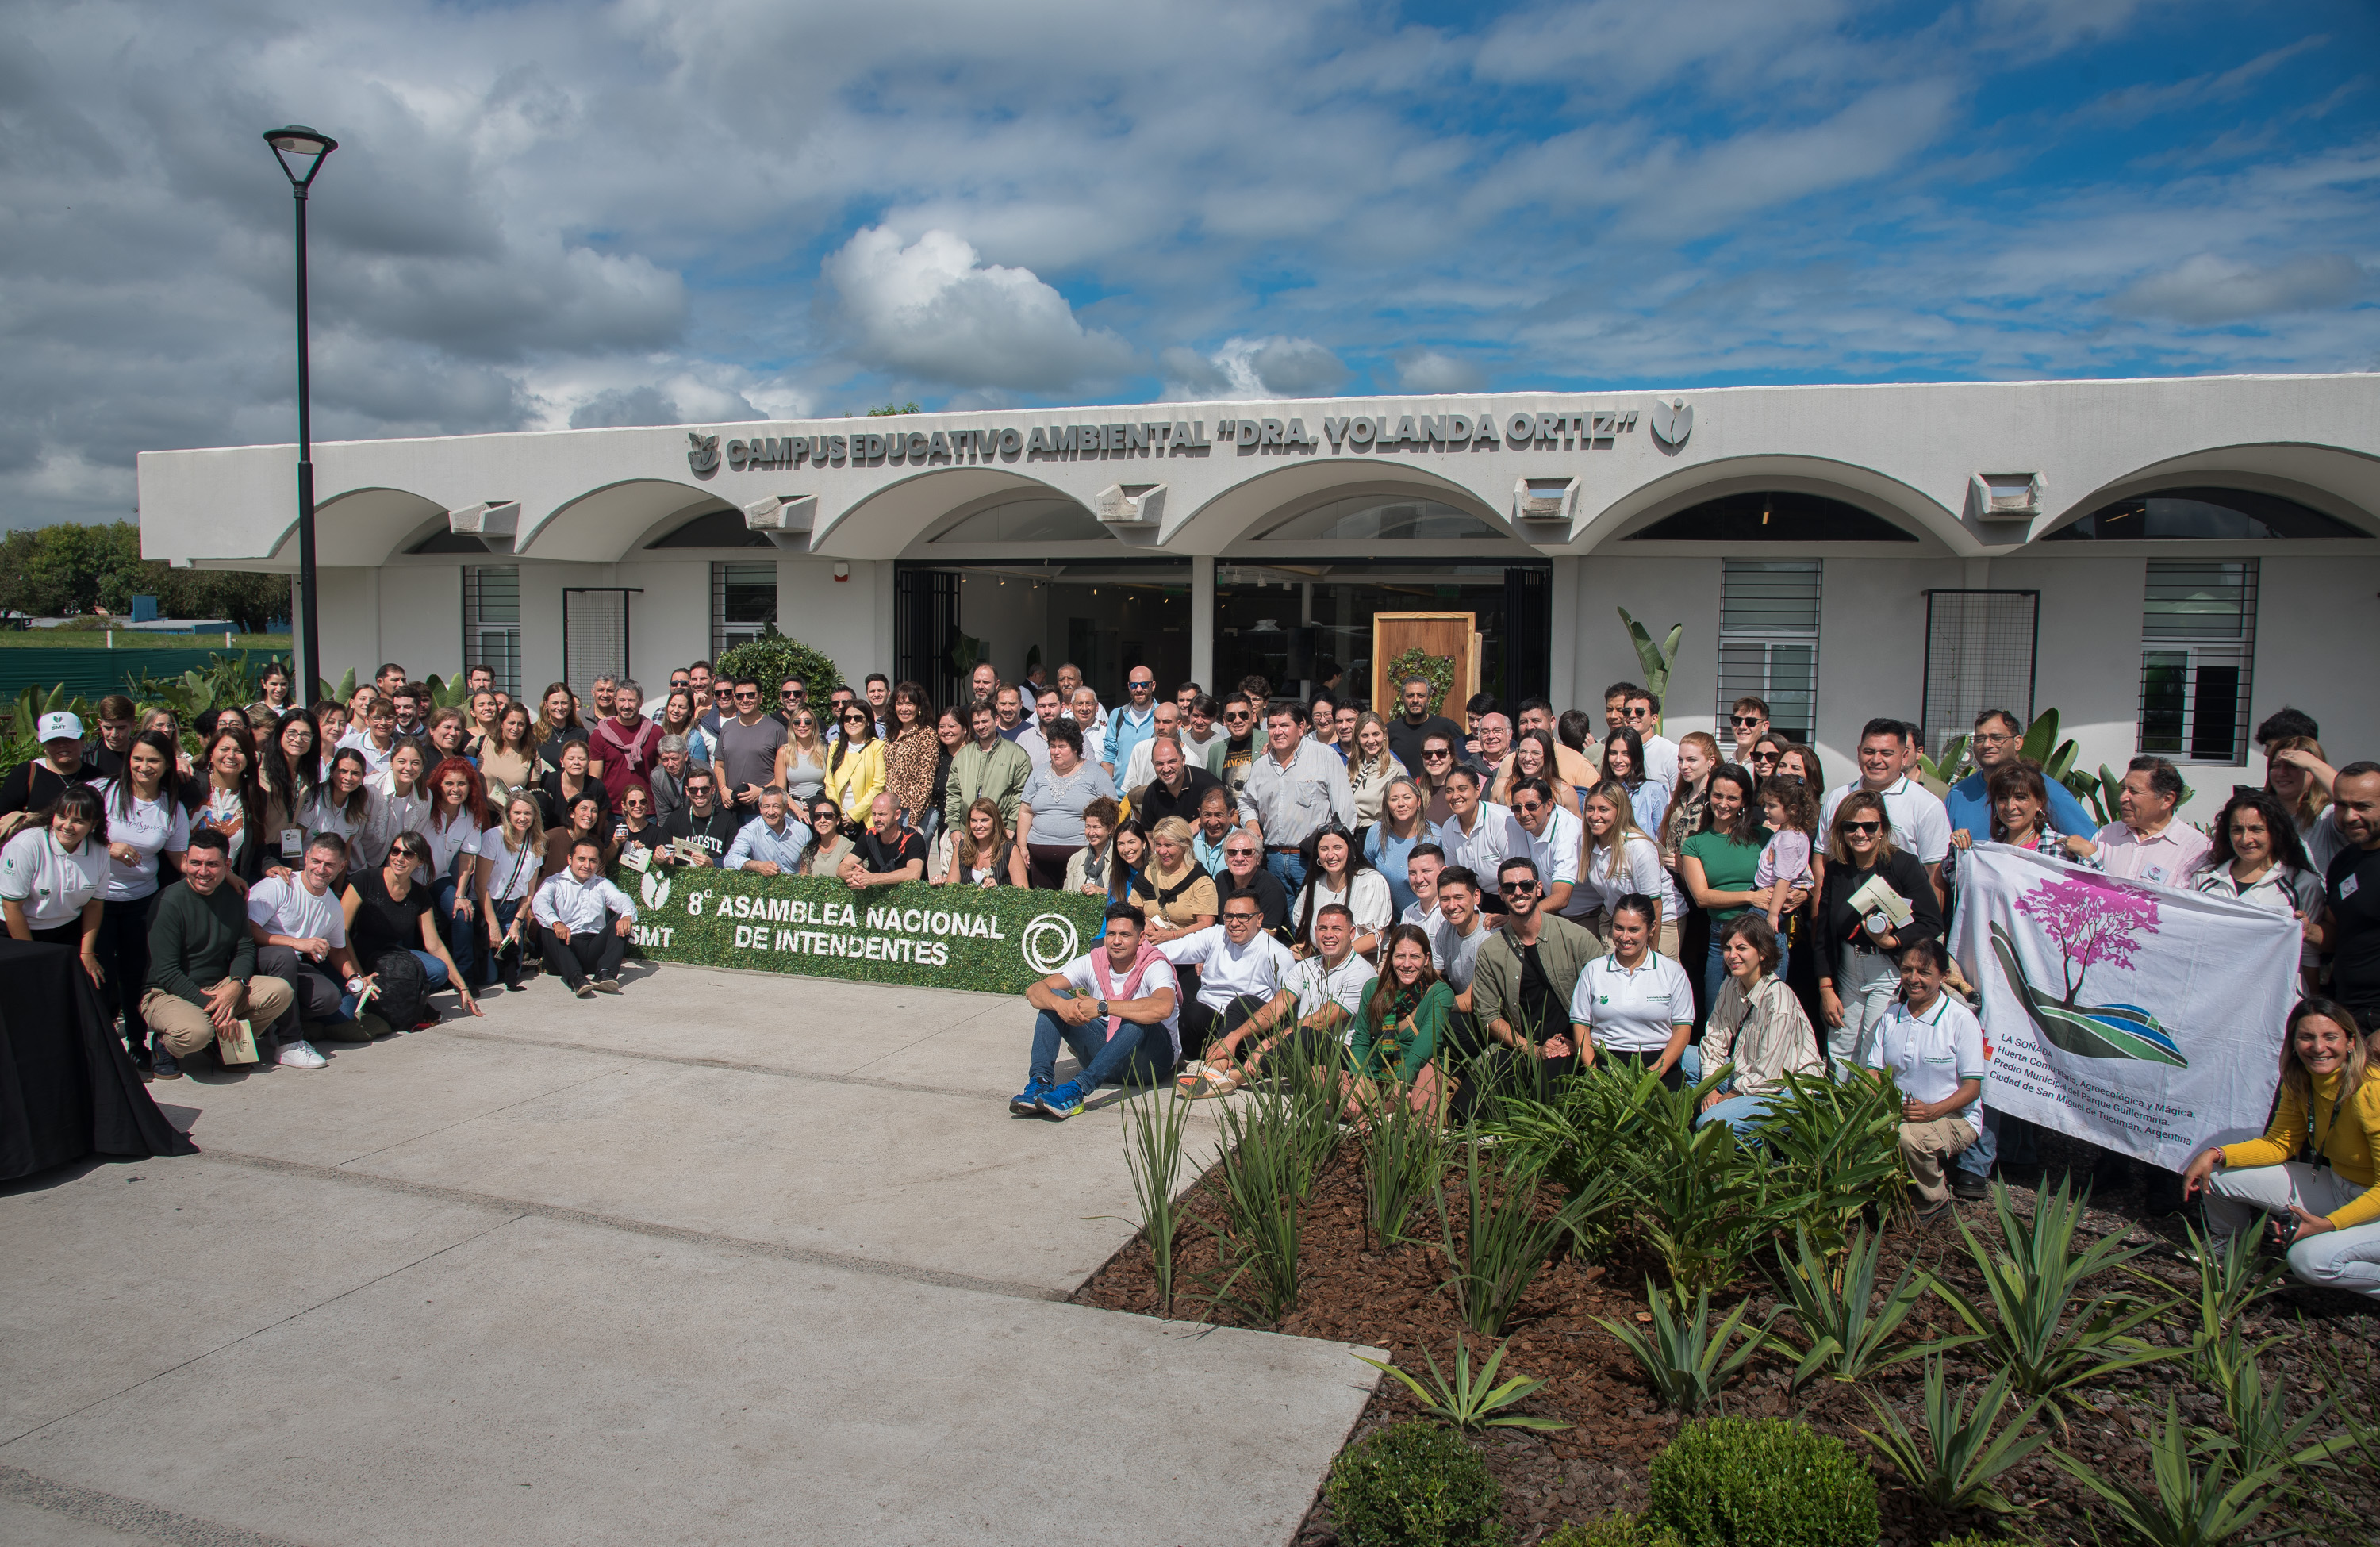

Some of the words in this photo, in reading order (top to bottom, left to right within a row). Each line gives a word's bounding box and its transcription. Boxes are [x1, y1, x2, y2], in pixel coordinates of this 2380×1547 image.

[726, 435, 847, 463] CAMPUS
[850, 428, 1023, 459] EDUCATIVO
[1026, 420, 1211, 452] AMBIENTAL
[1324, 413, 1501, 444] YOLANDA
[716, 894, 857, 927] ASAMBLEA
[866, 906, 1005, 939] NACIONAL
[735, 925, 769, 950] DE
[775, 929, 949, 966] INTENDENTES
[2001, 1033, 2013, 1044] LA
[2014, 1038, 2053, 1059] SOÑADA
[1993, 1057, 2022, 1074] Predio
[2023, 1068, 2067, 1091] Municipal
[2067, 1086, 2079, 1097] del
[2080, 1092, 2112, 1110] Parque
[2113, 1103, 2171, 1127] Guillermina.
[1997, 1045, 2028, 1063] Huerta
[2029, 1057, 2079, 1087] Comunitaria,
[2079, 1080, 2145, 1108] Agroecológica
[2146, 1102, 2153, 1111] y
[2155, 1103, 2196, 1119] Mágica.
[1989, 1069, 2021, 1088] Ciudad
[2022, 1081, 2034, 1092] de
[2036, 1086, 2055, 1100] San
[2056, 1093, 2085, 1111] Miguel
[2086, 1106, 2097, 1116] de
[2098, 1110, 2142, 1134] Tucumán,
[2144, 1126, 2193, 1146] Argentina
